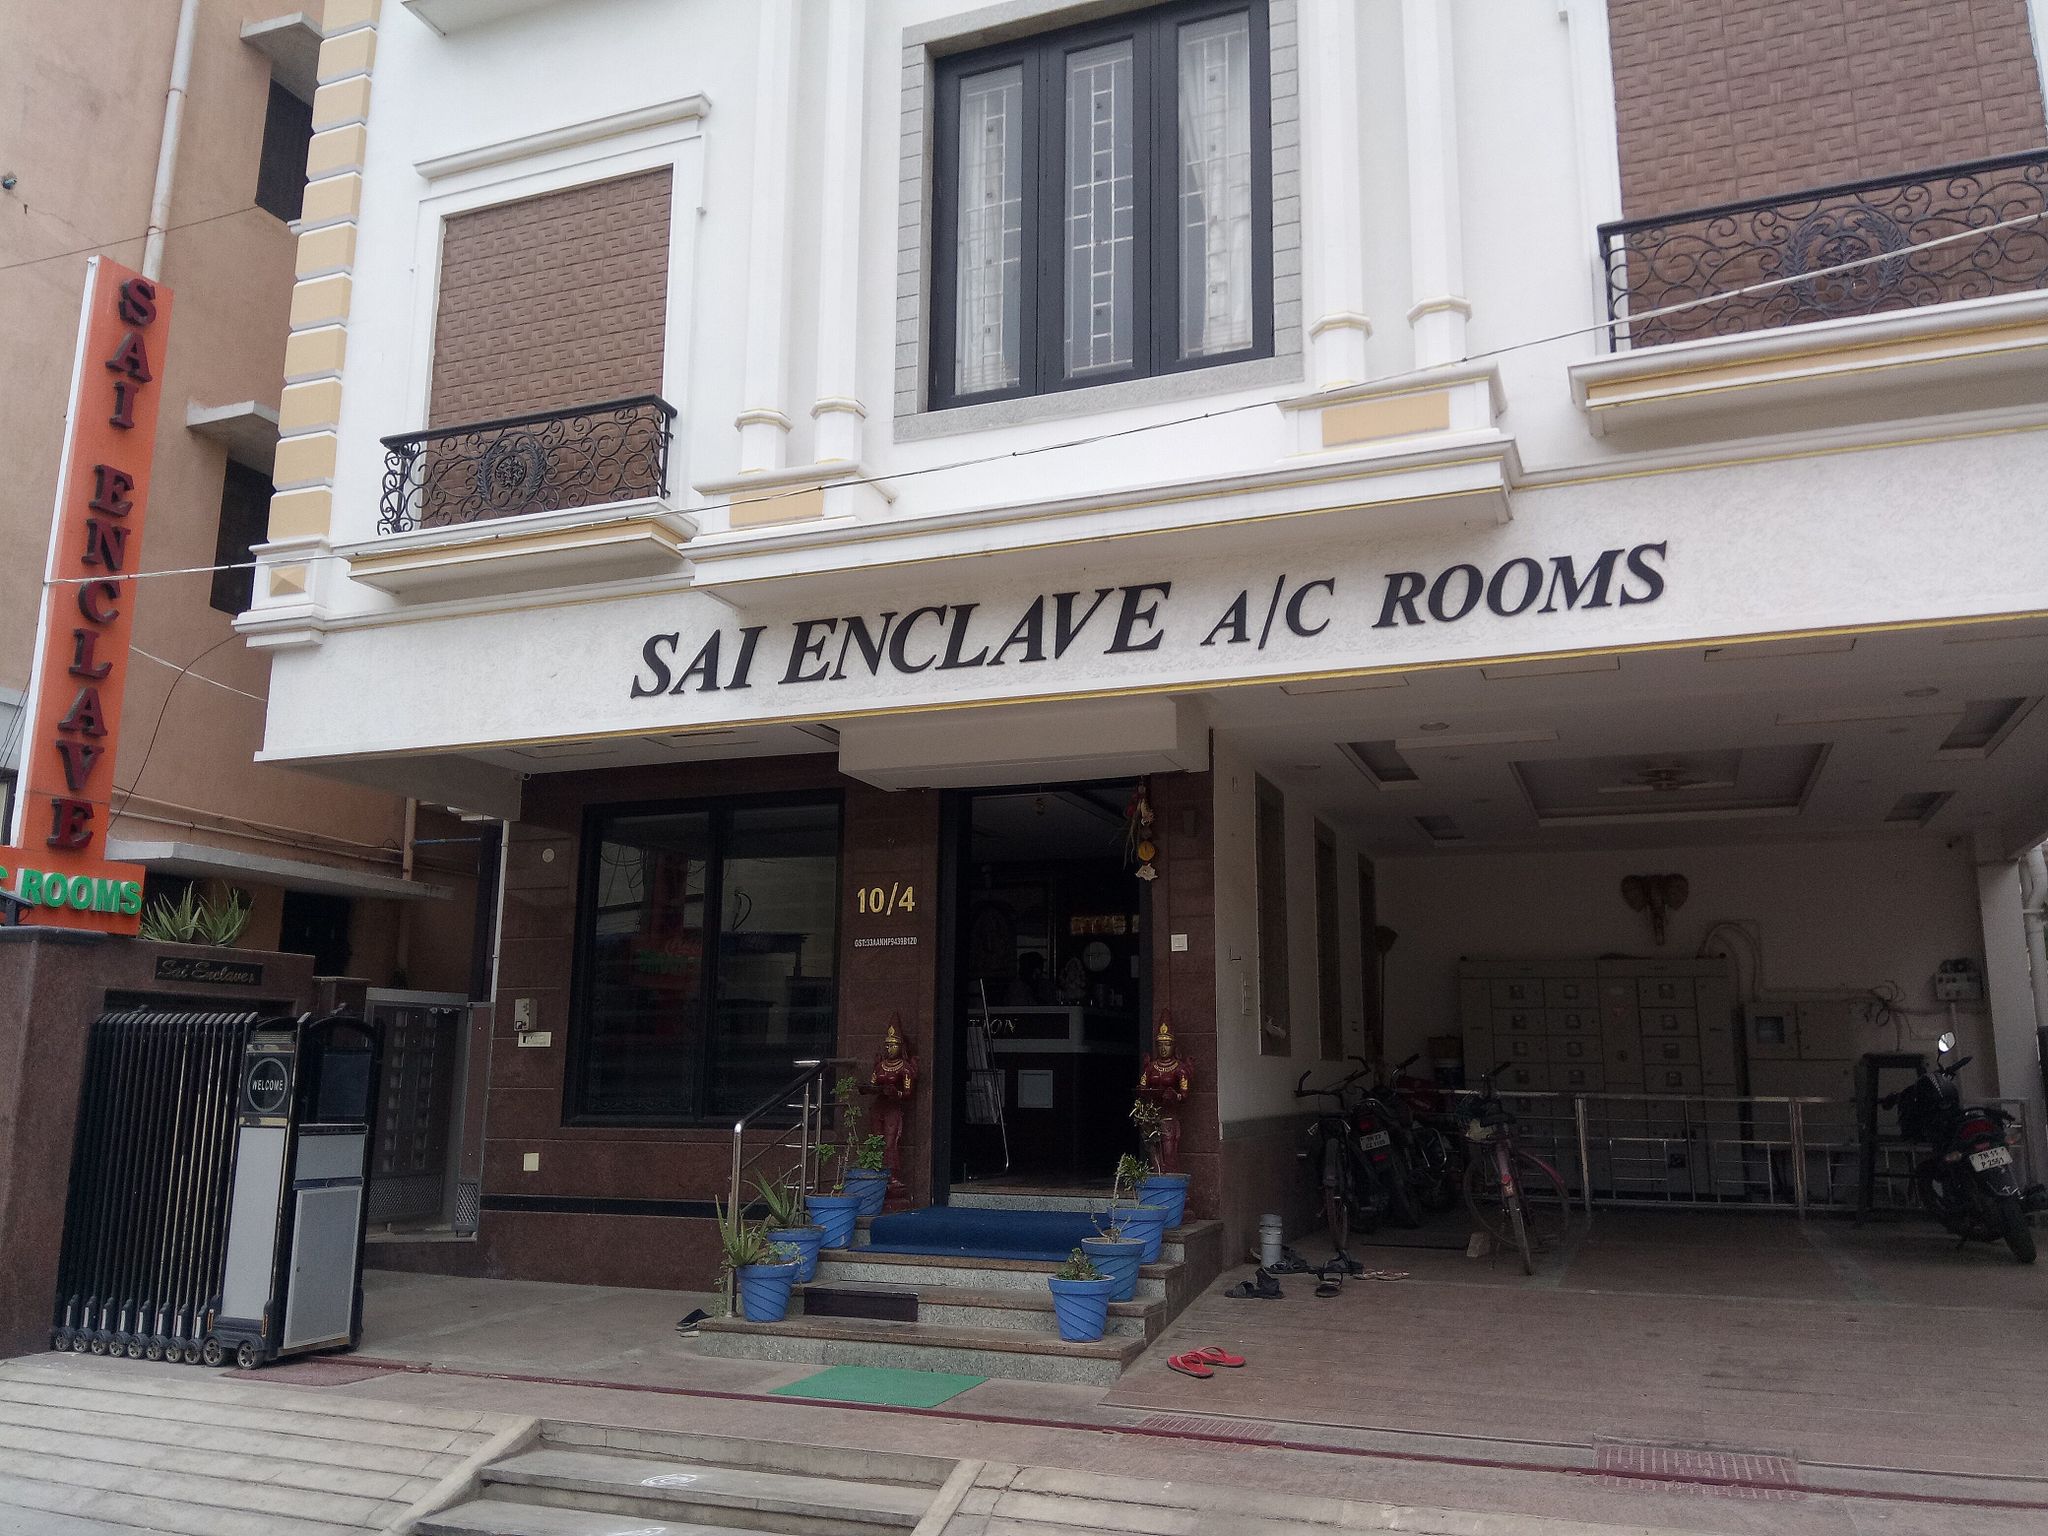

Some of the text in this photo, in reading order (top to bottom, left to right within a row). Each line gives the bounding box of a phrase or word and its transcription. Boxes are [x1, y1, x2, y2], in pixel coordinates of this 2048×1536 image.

[46, 277, 156, 850] SAI ENCLAVE
[630, 540, 1668, 700] SAI ENCLAVE A/C ROOMS
[16, 868, 143, 916] ROOMS
[857, 882, 916, 916] 10/4
[156, 959, 190, 980] Sai
[252, 1079, 284, 1092] WELCOME
